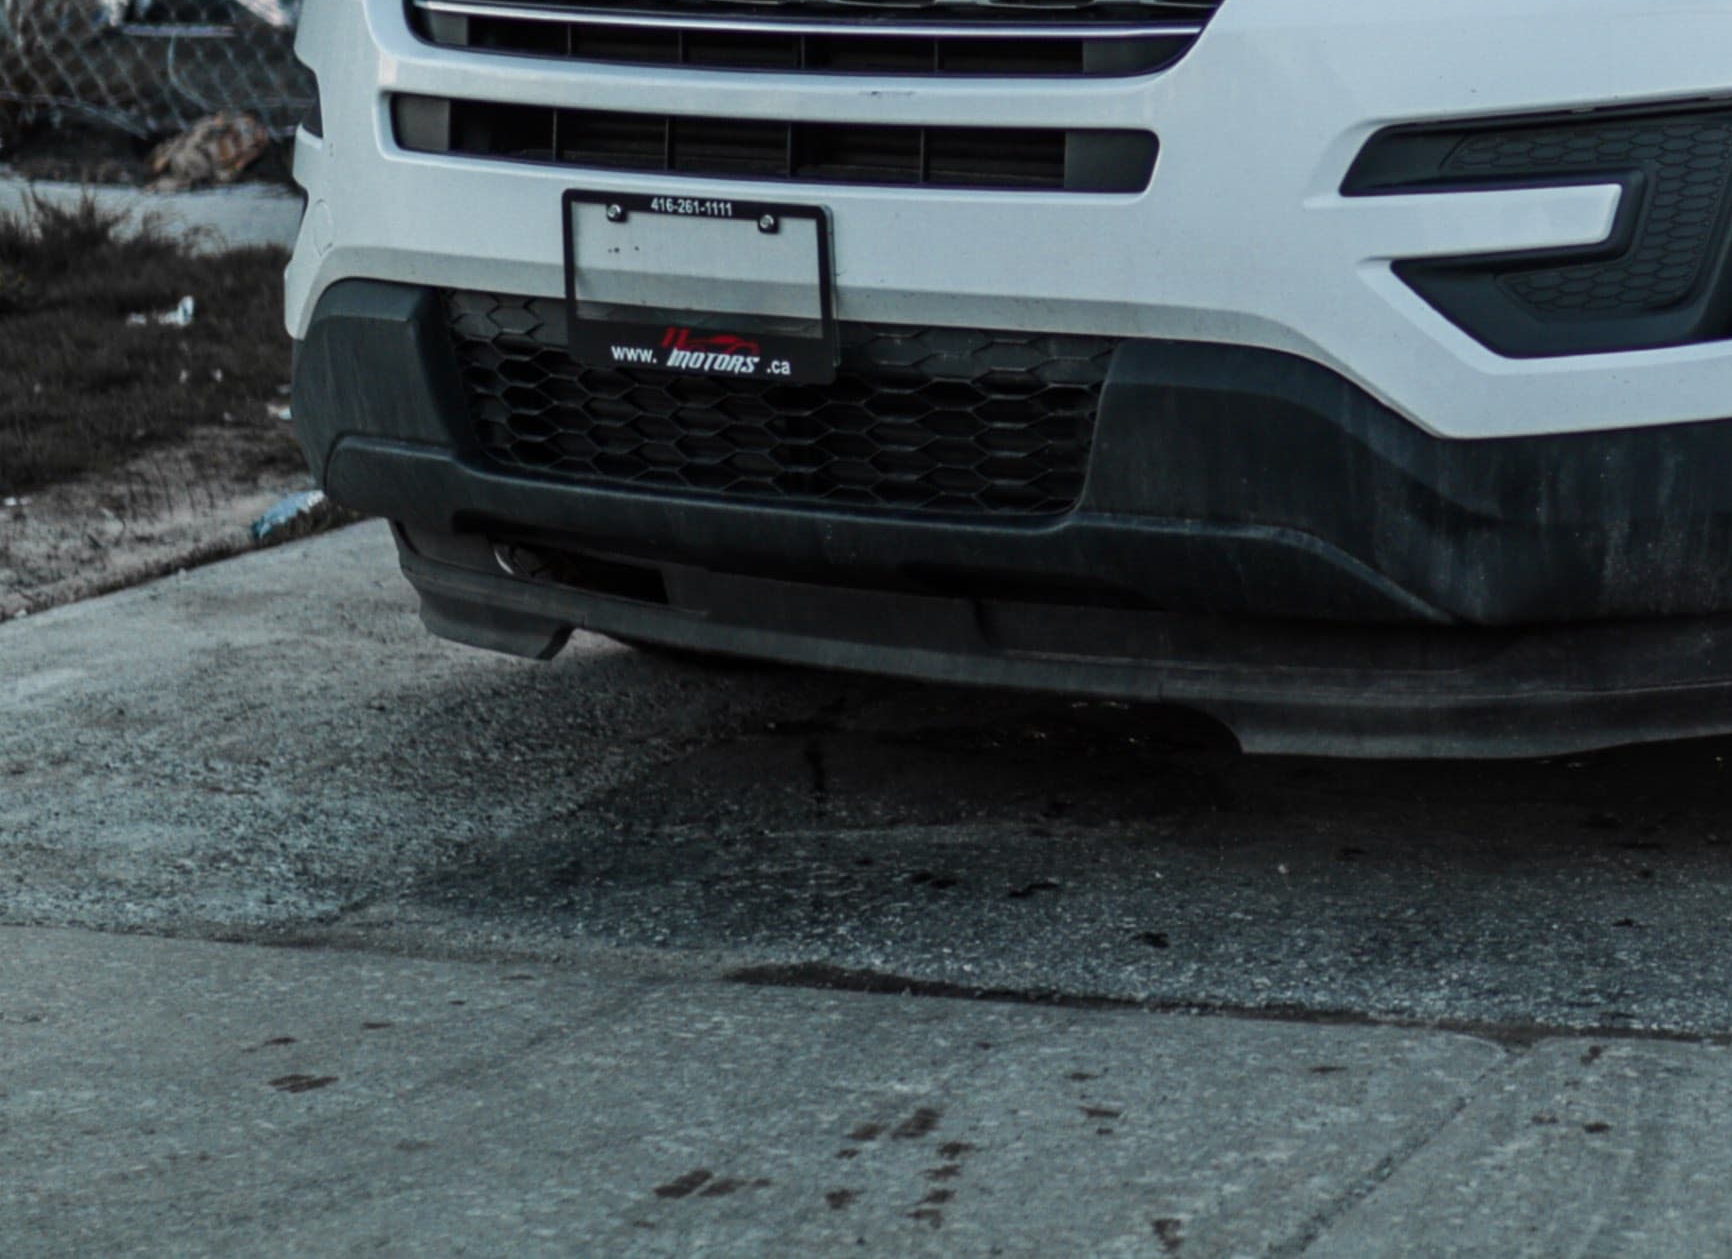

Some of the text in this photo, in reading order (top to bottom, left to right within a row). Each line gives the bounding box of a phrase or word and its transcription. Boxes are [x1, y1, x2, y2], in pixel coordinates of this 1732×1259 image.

[650, 197, 733, 217] 416-261-1111
[611, 345, 658, 364] www.
[766, 360, 791, 375] .ca
